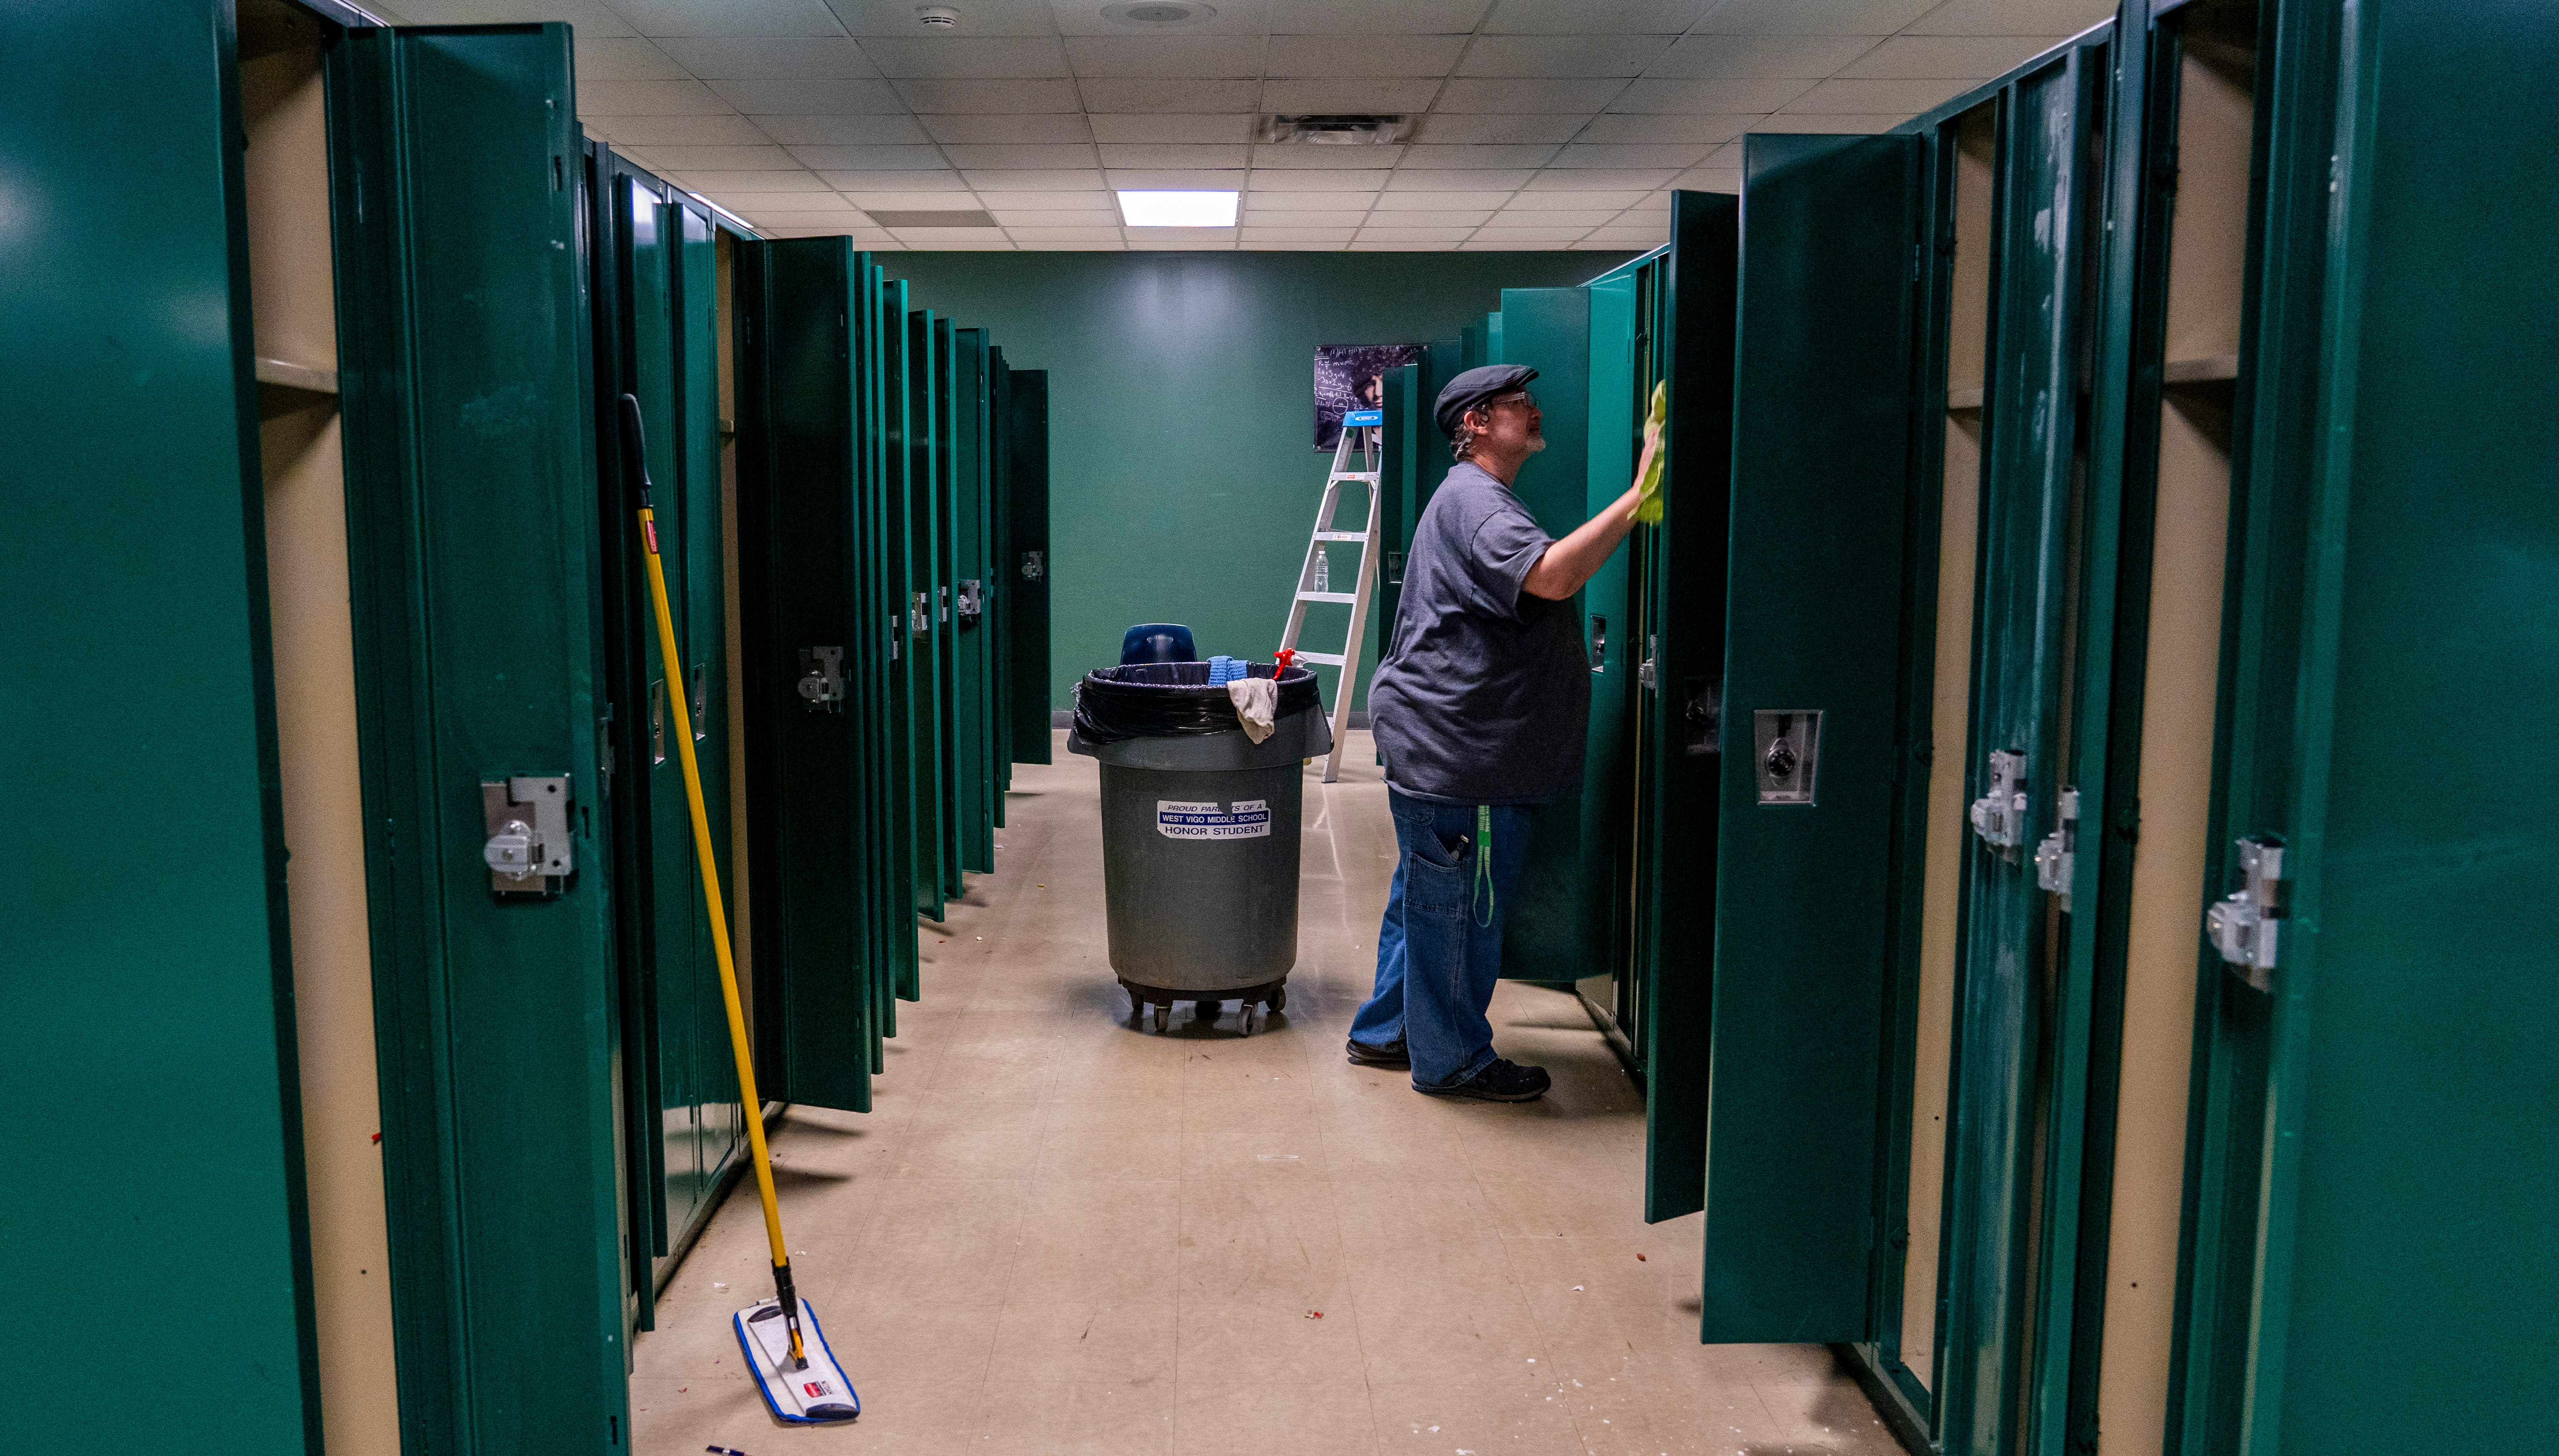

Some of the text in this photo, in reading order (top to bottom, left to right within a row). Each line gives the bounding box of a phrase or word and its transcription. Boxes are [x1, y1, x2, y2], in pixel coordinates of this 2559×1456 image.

[1238, 814, 1266, 822] SCHOOL
[1165, 825, 1264, 835] HONOR STUDENT
